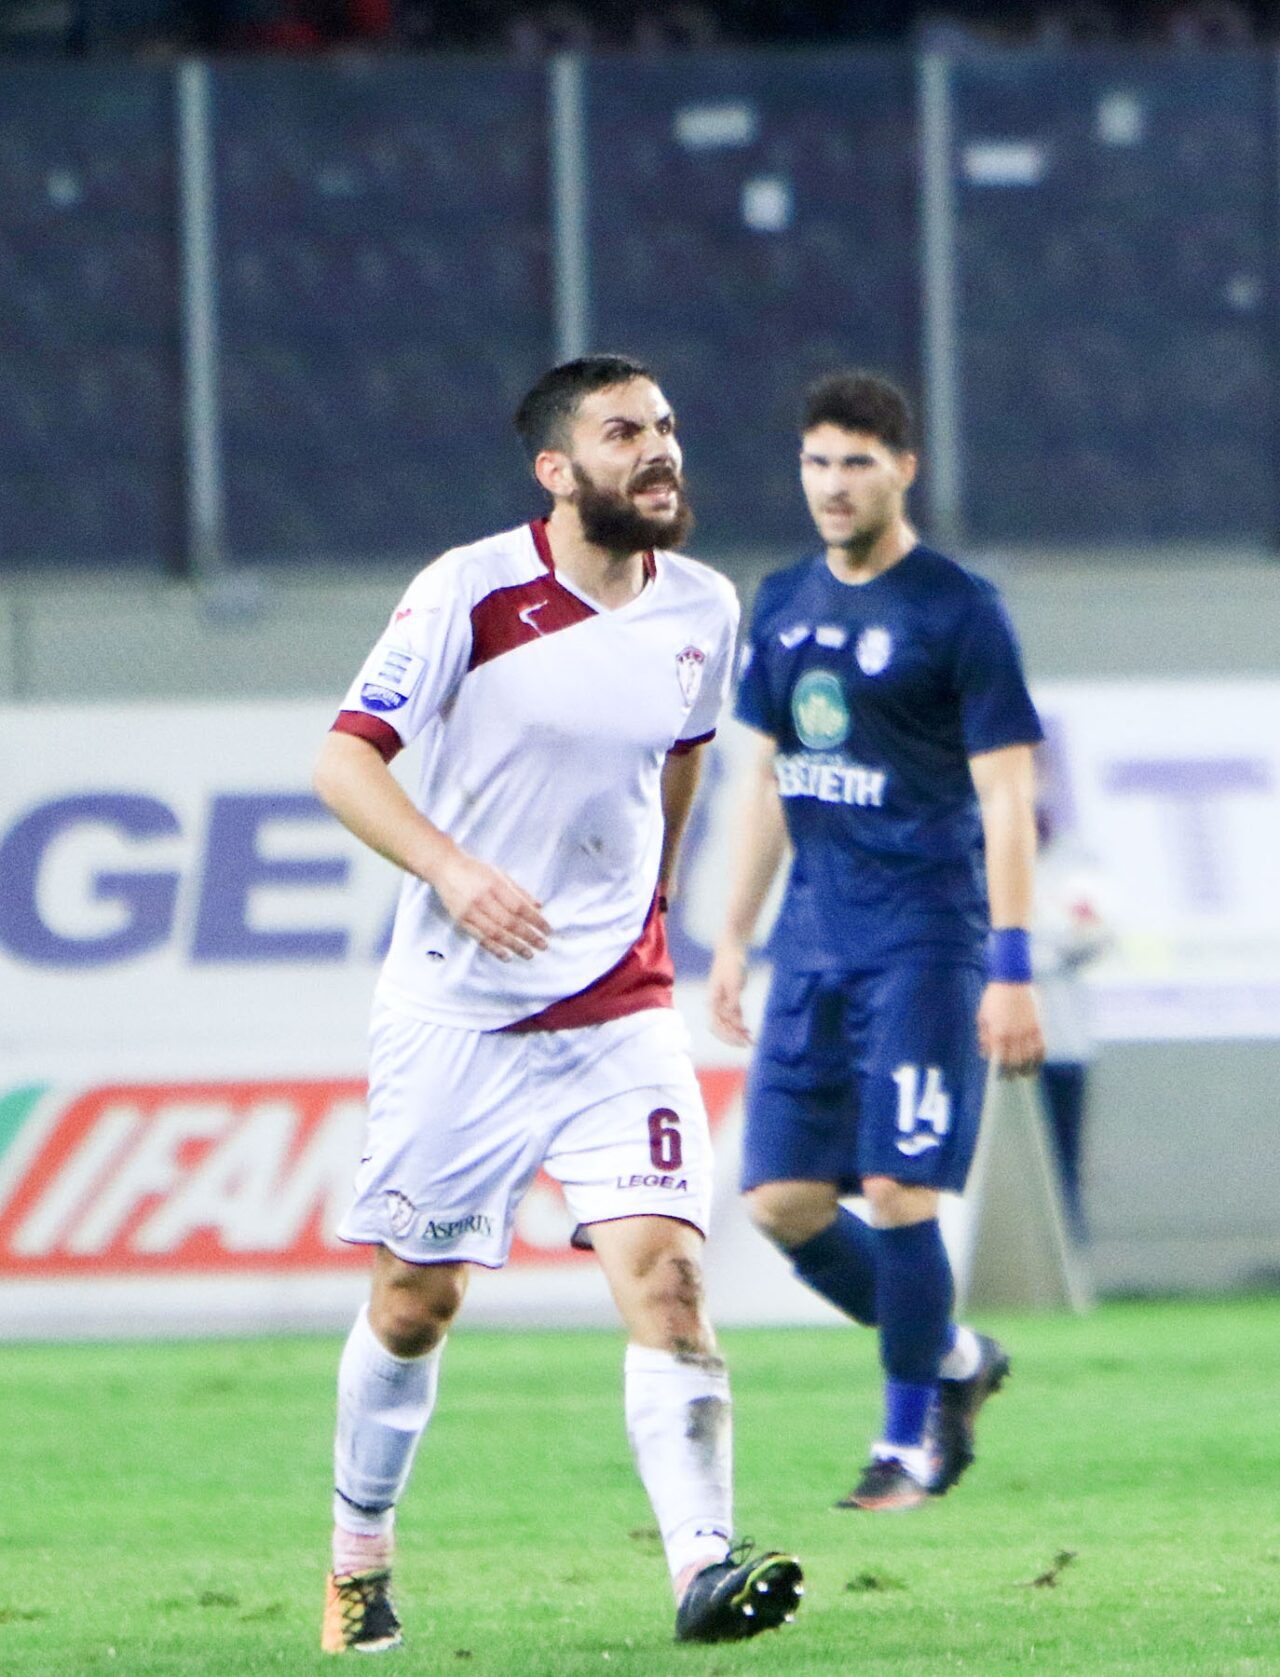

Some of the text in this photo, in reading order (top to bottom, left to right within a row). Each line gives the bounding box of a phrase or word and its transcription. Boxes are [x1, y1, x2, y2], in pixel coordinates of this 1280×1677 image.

[892, 1063, 950, 1135] 14
[647, 1107, 683, 1172] 6
[616, 1174, 688, 1192] LEGEA
